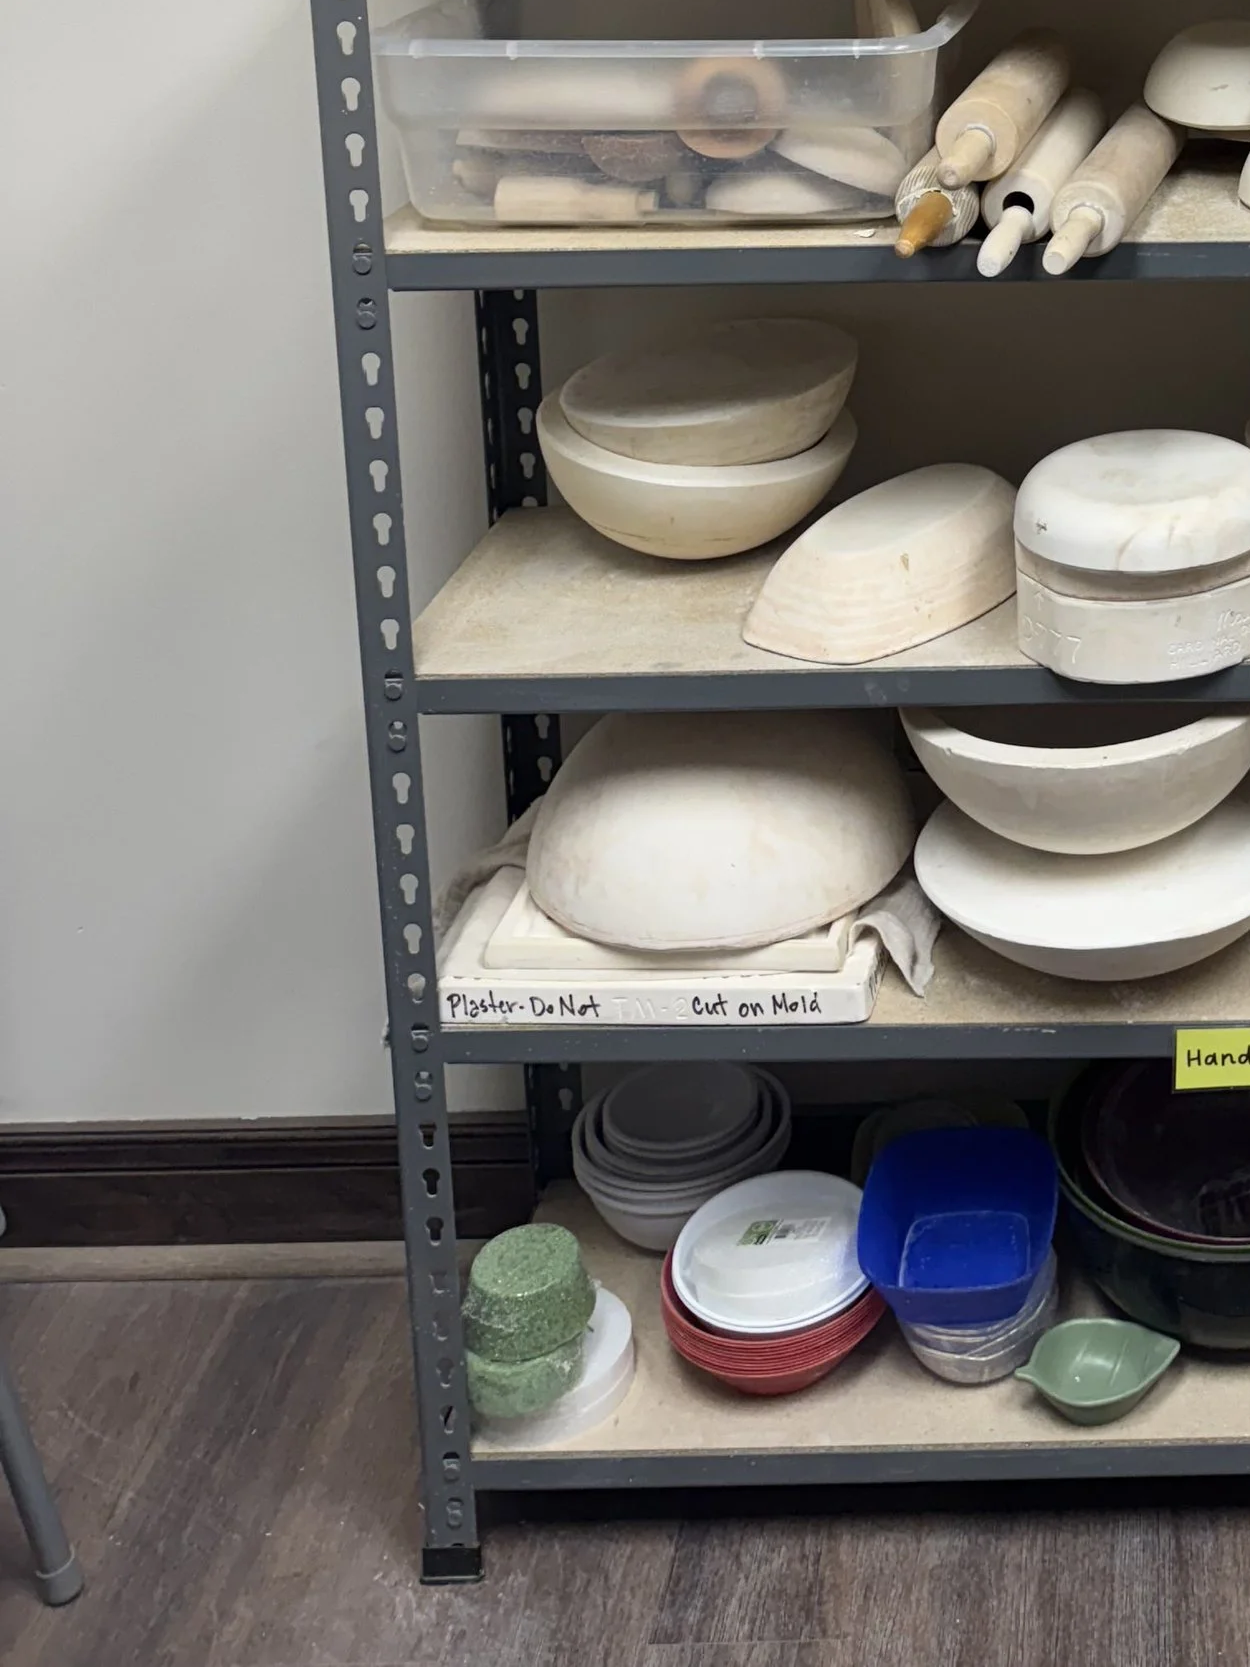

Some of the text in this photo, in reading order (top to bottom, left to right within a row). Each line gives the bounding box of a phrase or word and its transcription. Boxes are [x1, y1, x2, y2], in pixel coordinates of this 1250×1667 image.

[530, 996, 554, 1017] Do
[559, 994, 601, 1018] Not
[692, 994, 728, 1016] Cut
[738, 1001, 765, 1018] on
[772, 992, 822, 1015] Mold
